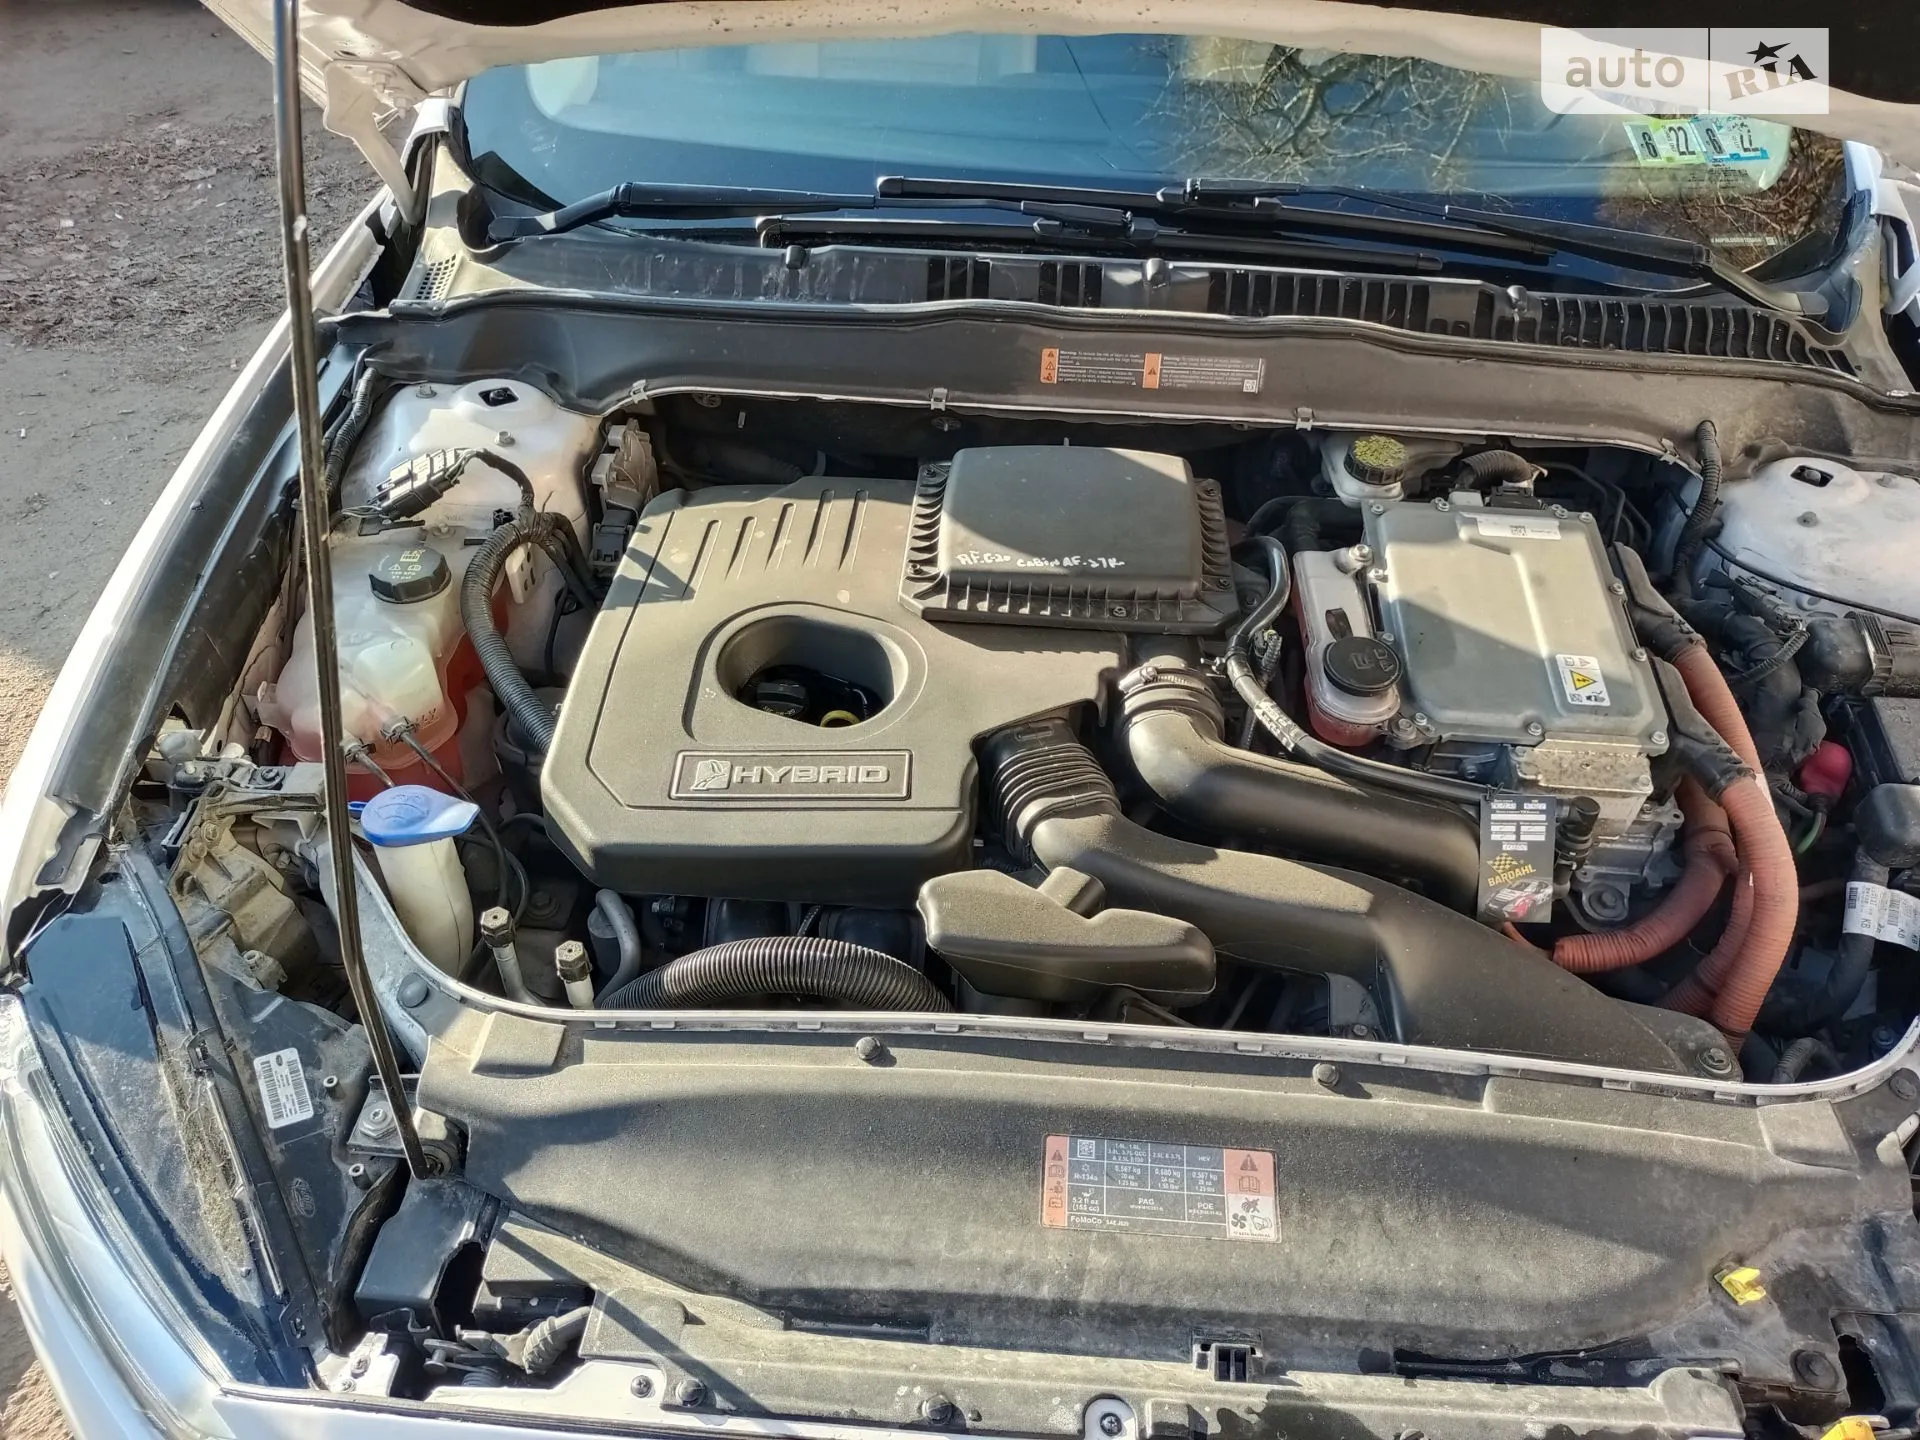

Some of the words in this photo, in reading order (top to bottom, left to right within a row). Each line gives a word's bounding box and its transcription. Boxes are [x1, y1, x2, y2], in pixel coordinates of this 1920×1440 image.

[1669, 125, 1697, 156] 22
[733, 765, 890, 784] HYBRID
[1487, 863, 1537, 888] BARDAHL
[1138, 1197, 1155, 1206] PAG
[1197, 1202, 1214, 1210] POE
[1070, 1216, 1103, 1225] FoMoCo
